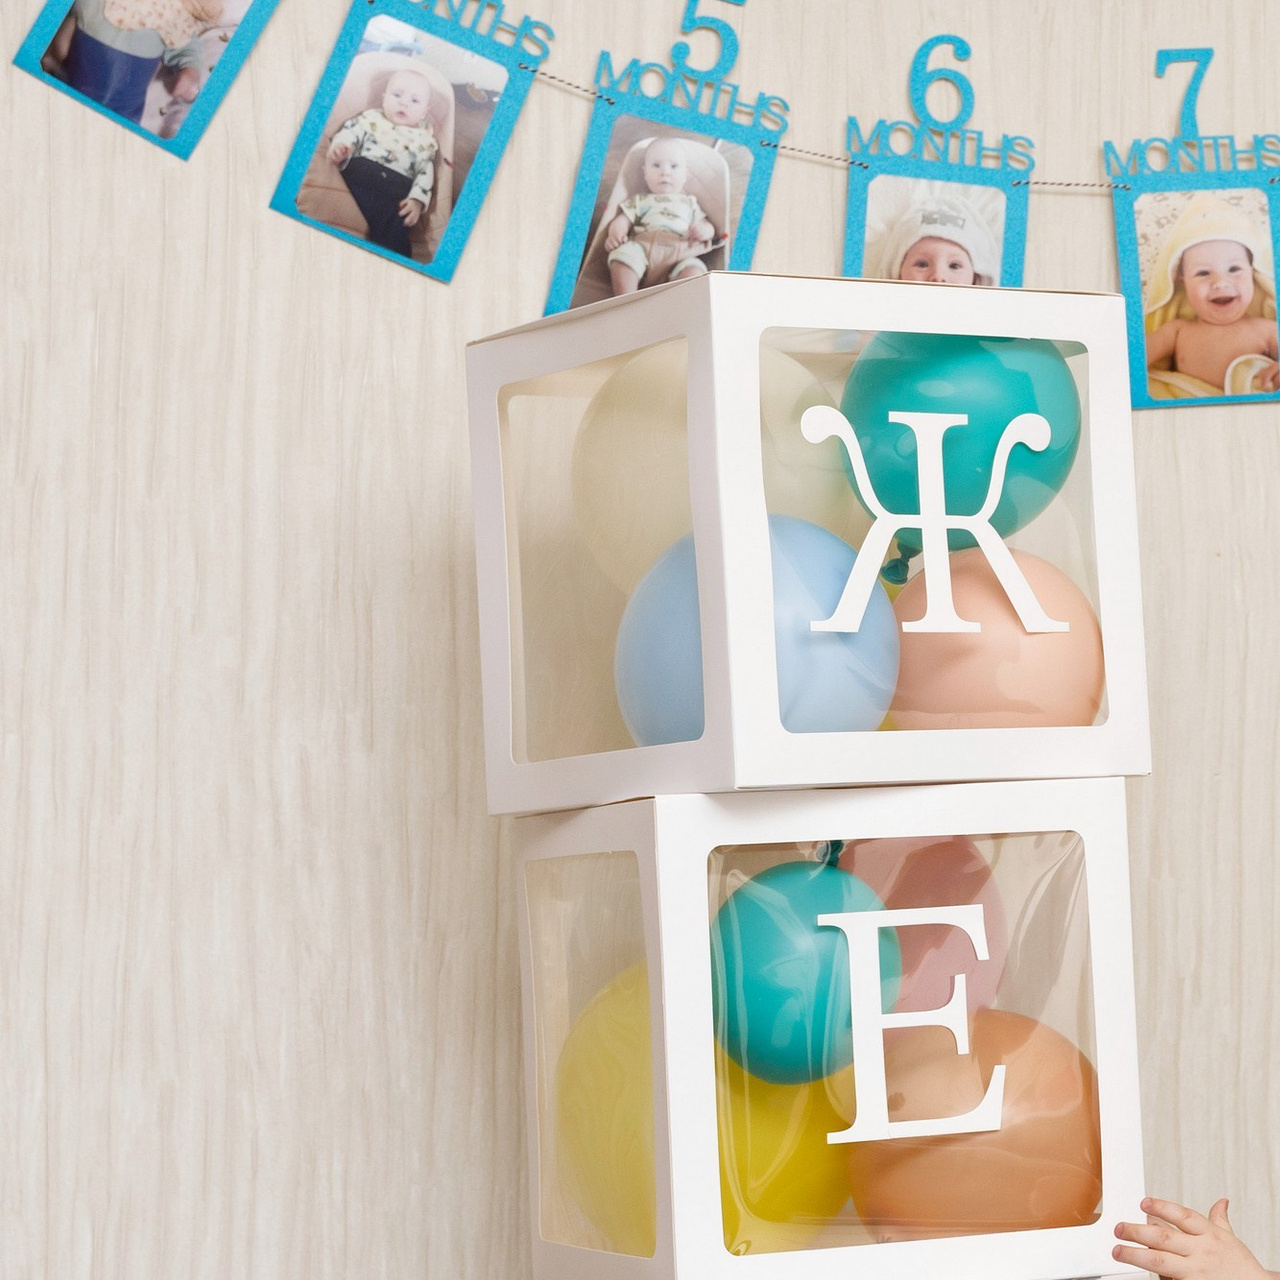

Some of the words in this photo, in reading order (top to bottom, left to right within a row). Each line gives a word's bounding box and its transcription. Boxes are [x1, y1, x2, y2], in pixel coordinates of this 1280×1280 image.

[593, 50, 790, 134] MONTHS
[908, 34, 975, 131] 6
[1155, 47, 1215, 140] 7
[846, 116, 1035, 174] MONTHS
[800, 405, 1070, 634] Ж
[817, 903, 1006, 1145] Е
